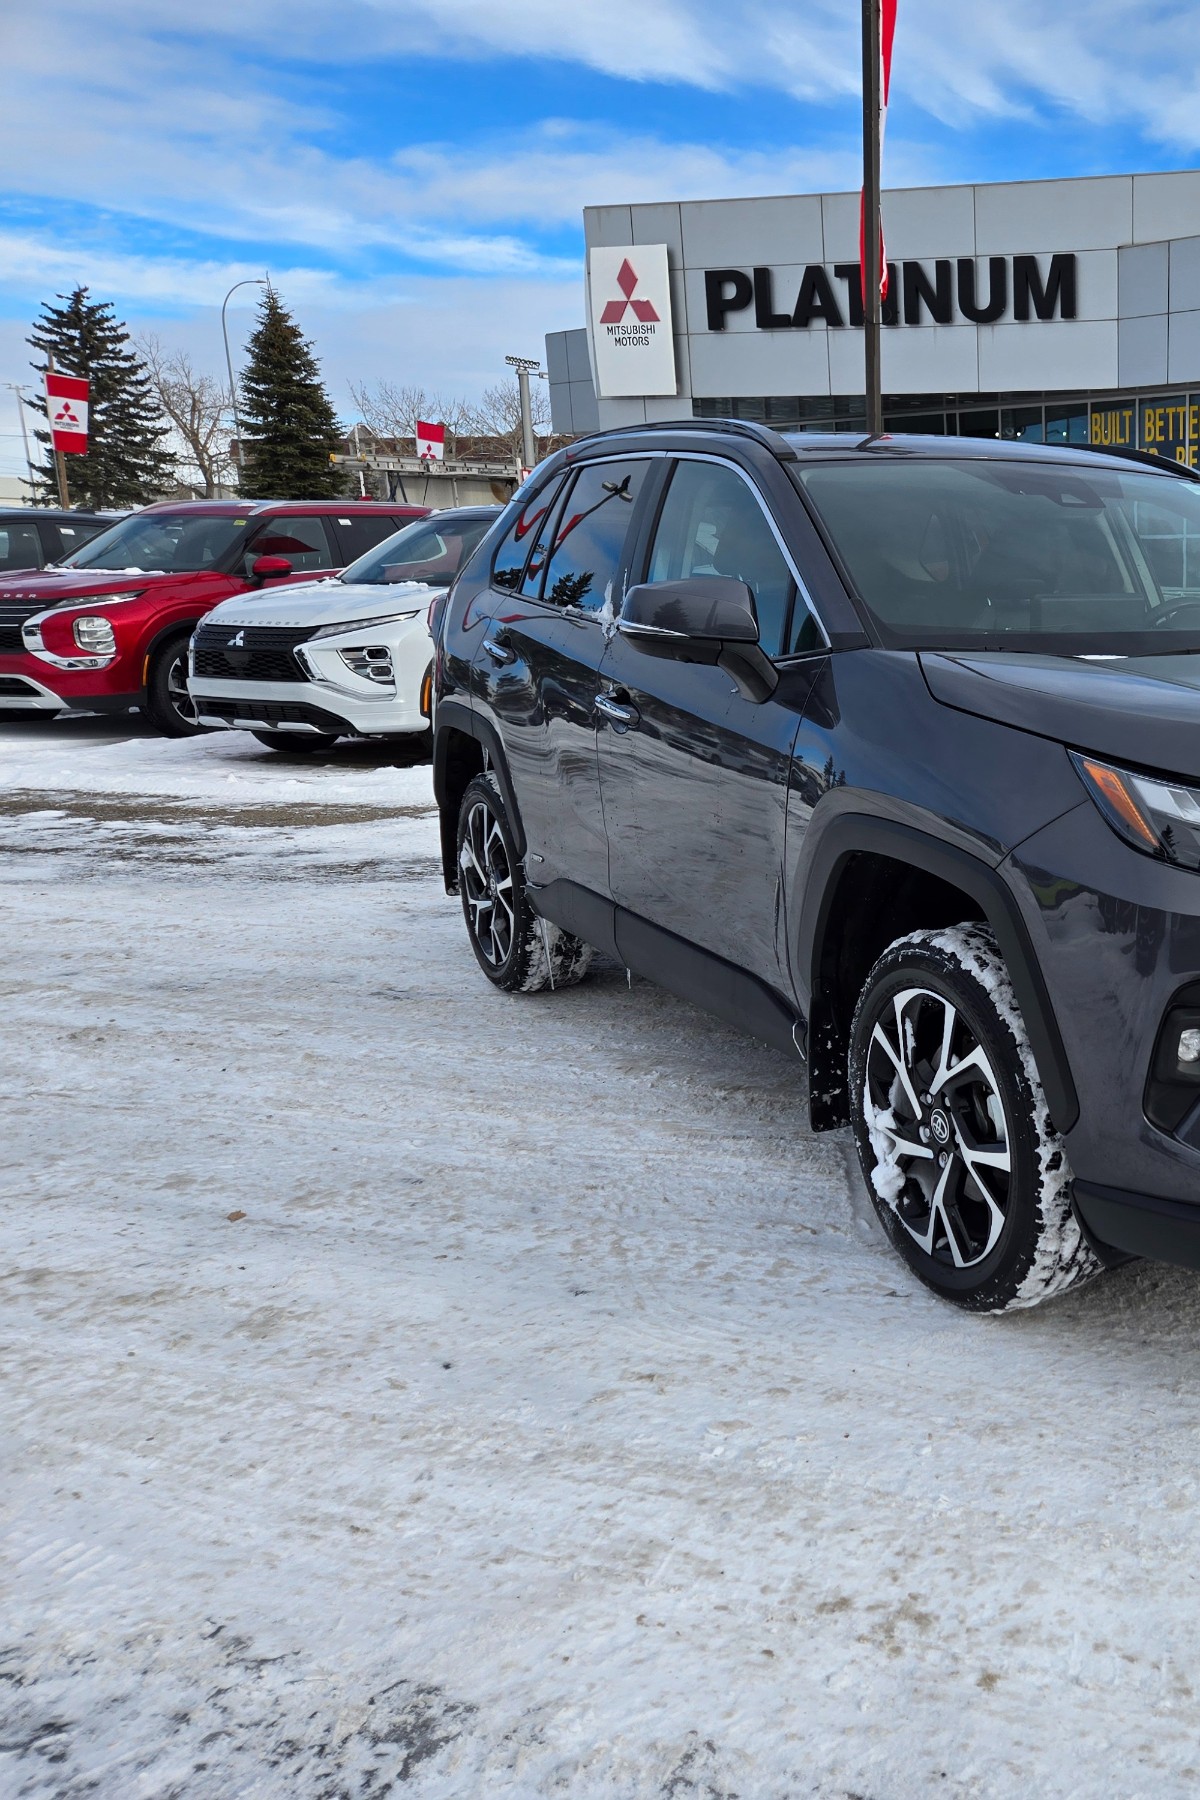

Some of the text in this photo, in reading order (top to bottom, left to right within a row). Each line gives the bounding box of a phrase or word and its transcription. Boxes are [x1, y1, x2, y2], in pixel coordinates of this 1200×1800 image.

[704, 253, 1077, 331] PLATINUM
[606, 325, 656, 336] MITSUBISHI
[614, 337, 650, 347] MOTORS
[1091, 411, 1133, 445] BUILT
